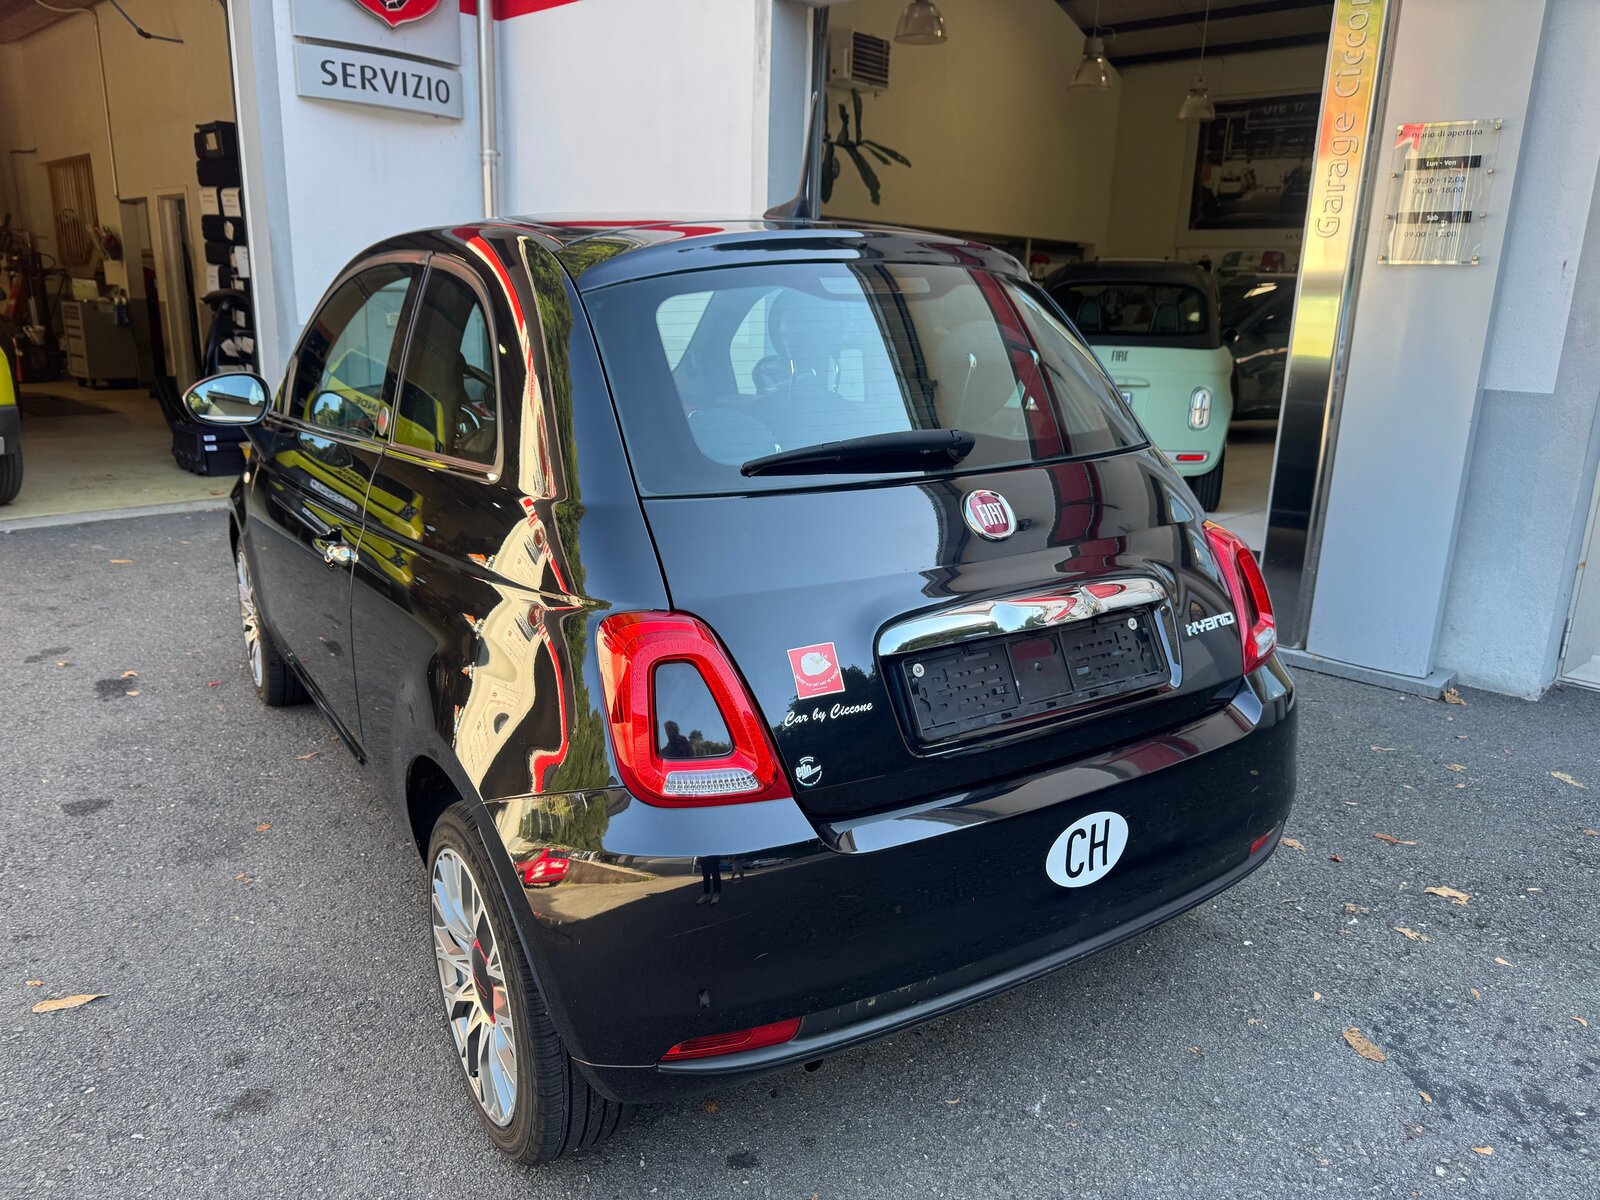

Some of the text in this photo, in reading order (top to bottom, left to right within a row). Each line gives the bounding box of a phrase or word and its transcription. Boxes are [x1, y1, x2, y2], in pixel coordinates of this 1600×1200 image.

[320, 59, 450, 104] SERVIZIO
[1315, 111, 1359, 239] Garage
[1111, 350, 1129, 362] FIAT
[976, 502, 1006, 526] FIAT
[1185, 611, 1235, 637] HYBRID
[784, 702, 874, 727] Car by Ciccone
[1065, 818, 1111, 879] CH
